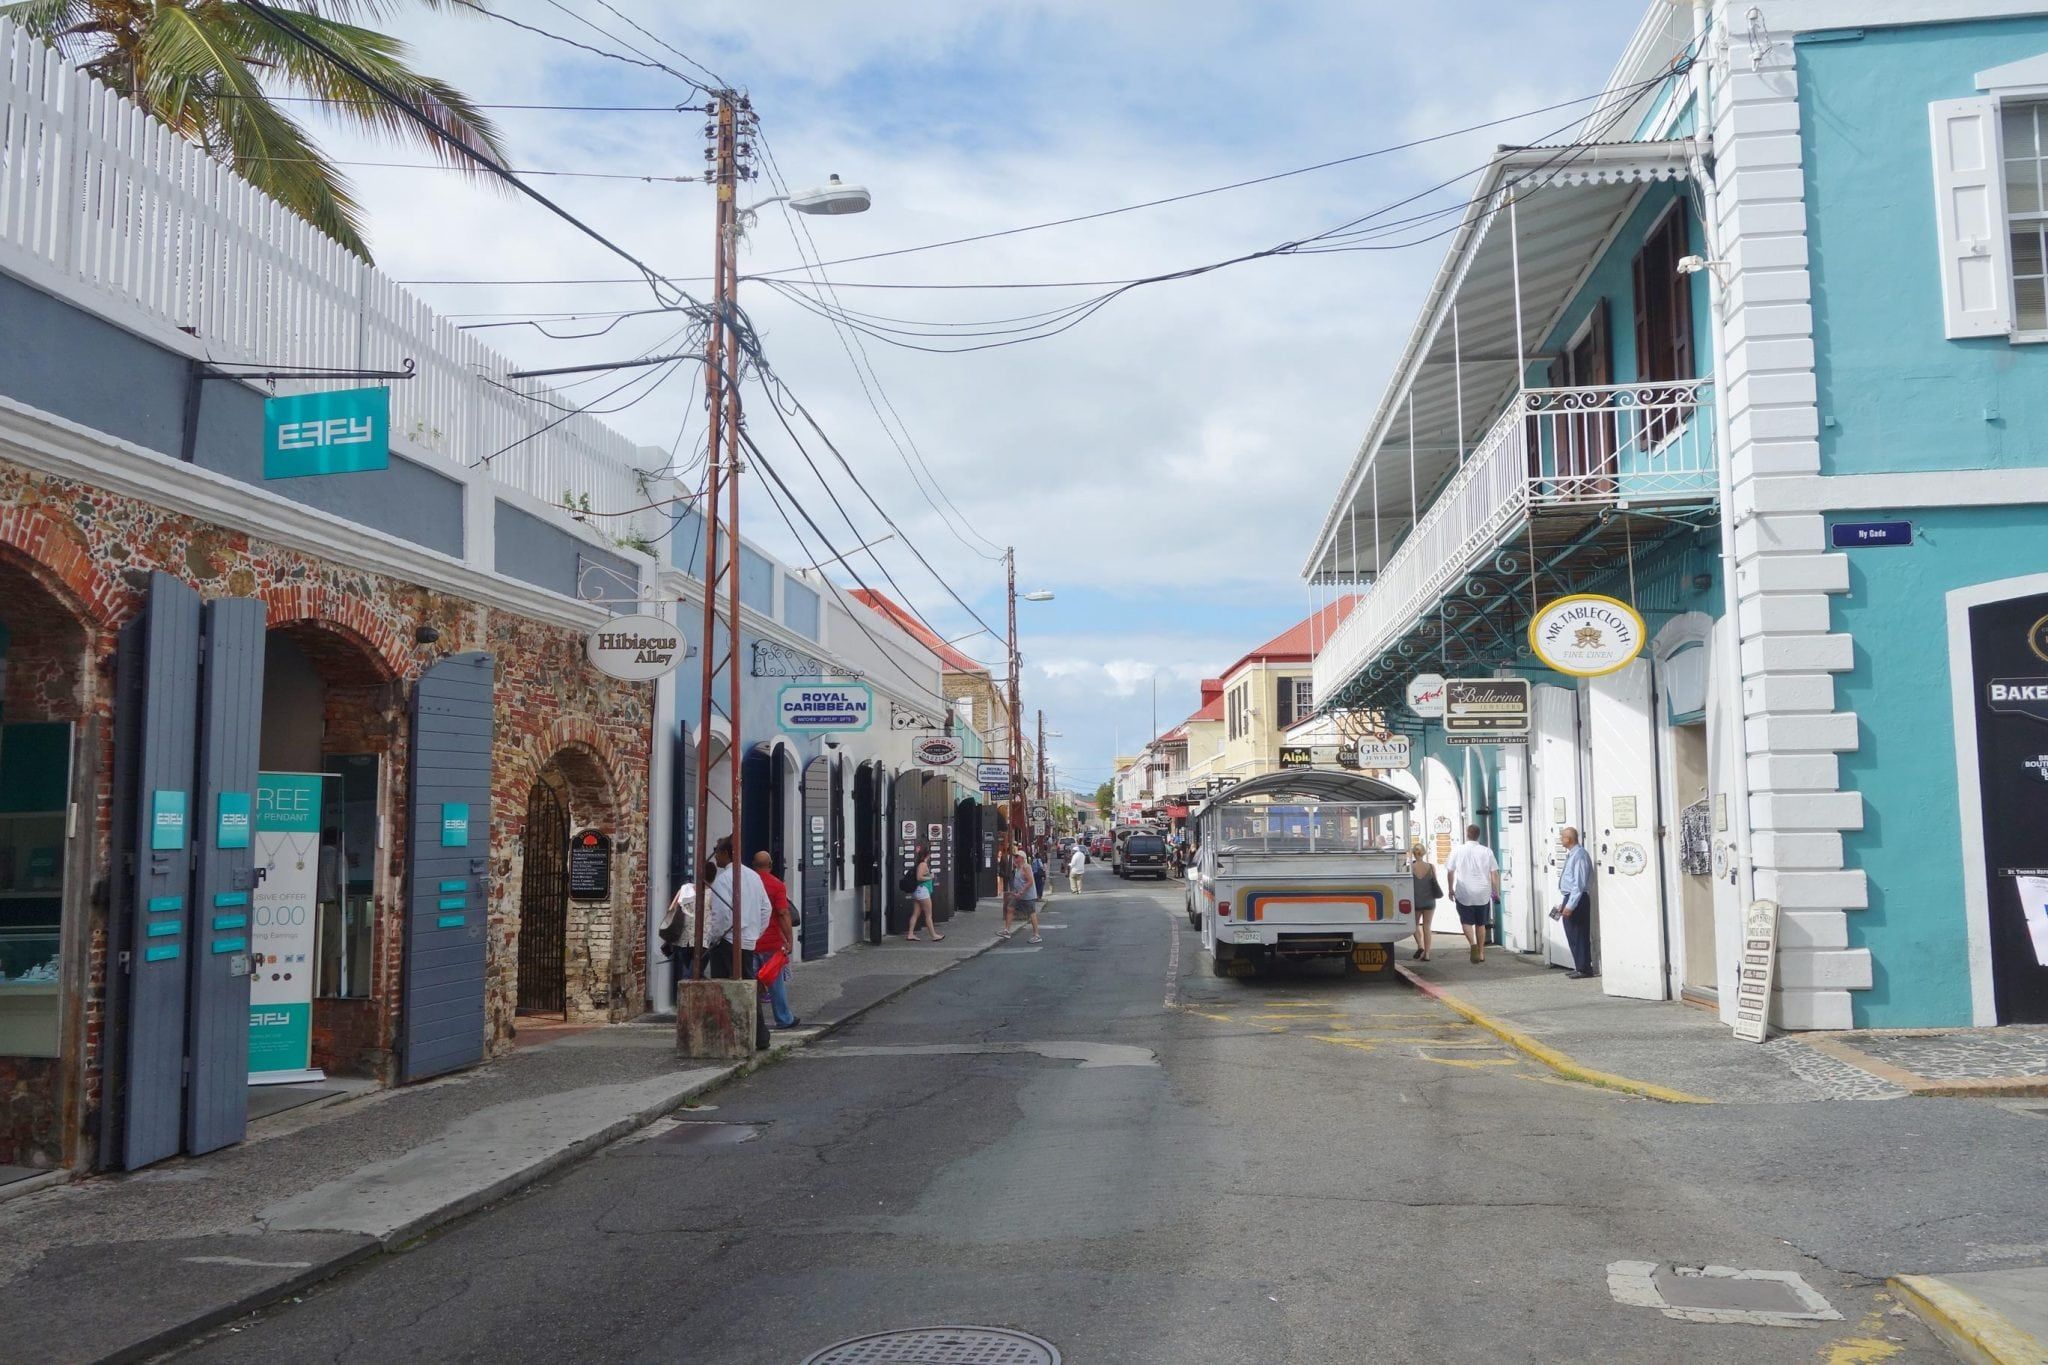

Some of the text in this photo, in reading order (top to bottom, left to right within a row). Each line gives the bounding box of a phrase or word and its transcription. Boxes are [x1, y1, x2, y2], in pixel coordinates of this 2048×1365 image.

[1858, 529, 1887, 539] Ny Gade
[1546, 607, 1631, 643] MR. TABLECLOTH
[598, 633, 677, 650] Hibiscus
[634, 650, 673, 666] Alley
[802, 693, 849, 702] ROYAL
[1463, 687, 1522, 703] Ballerina
[784, 702, 867, 711] CARIBBEAN
[1360, 743, 1407, 755] GRAND
[1282, 752, 1310, 763] Alph
[265, 813, 310, 821] PENDANT
[1034, 810, 1046, 818] 308
[279, 893, 306, 901] OFFER
[1359, 950, 1382, 964] NAPA
